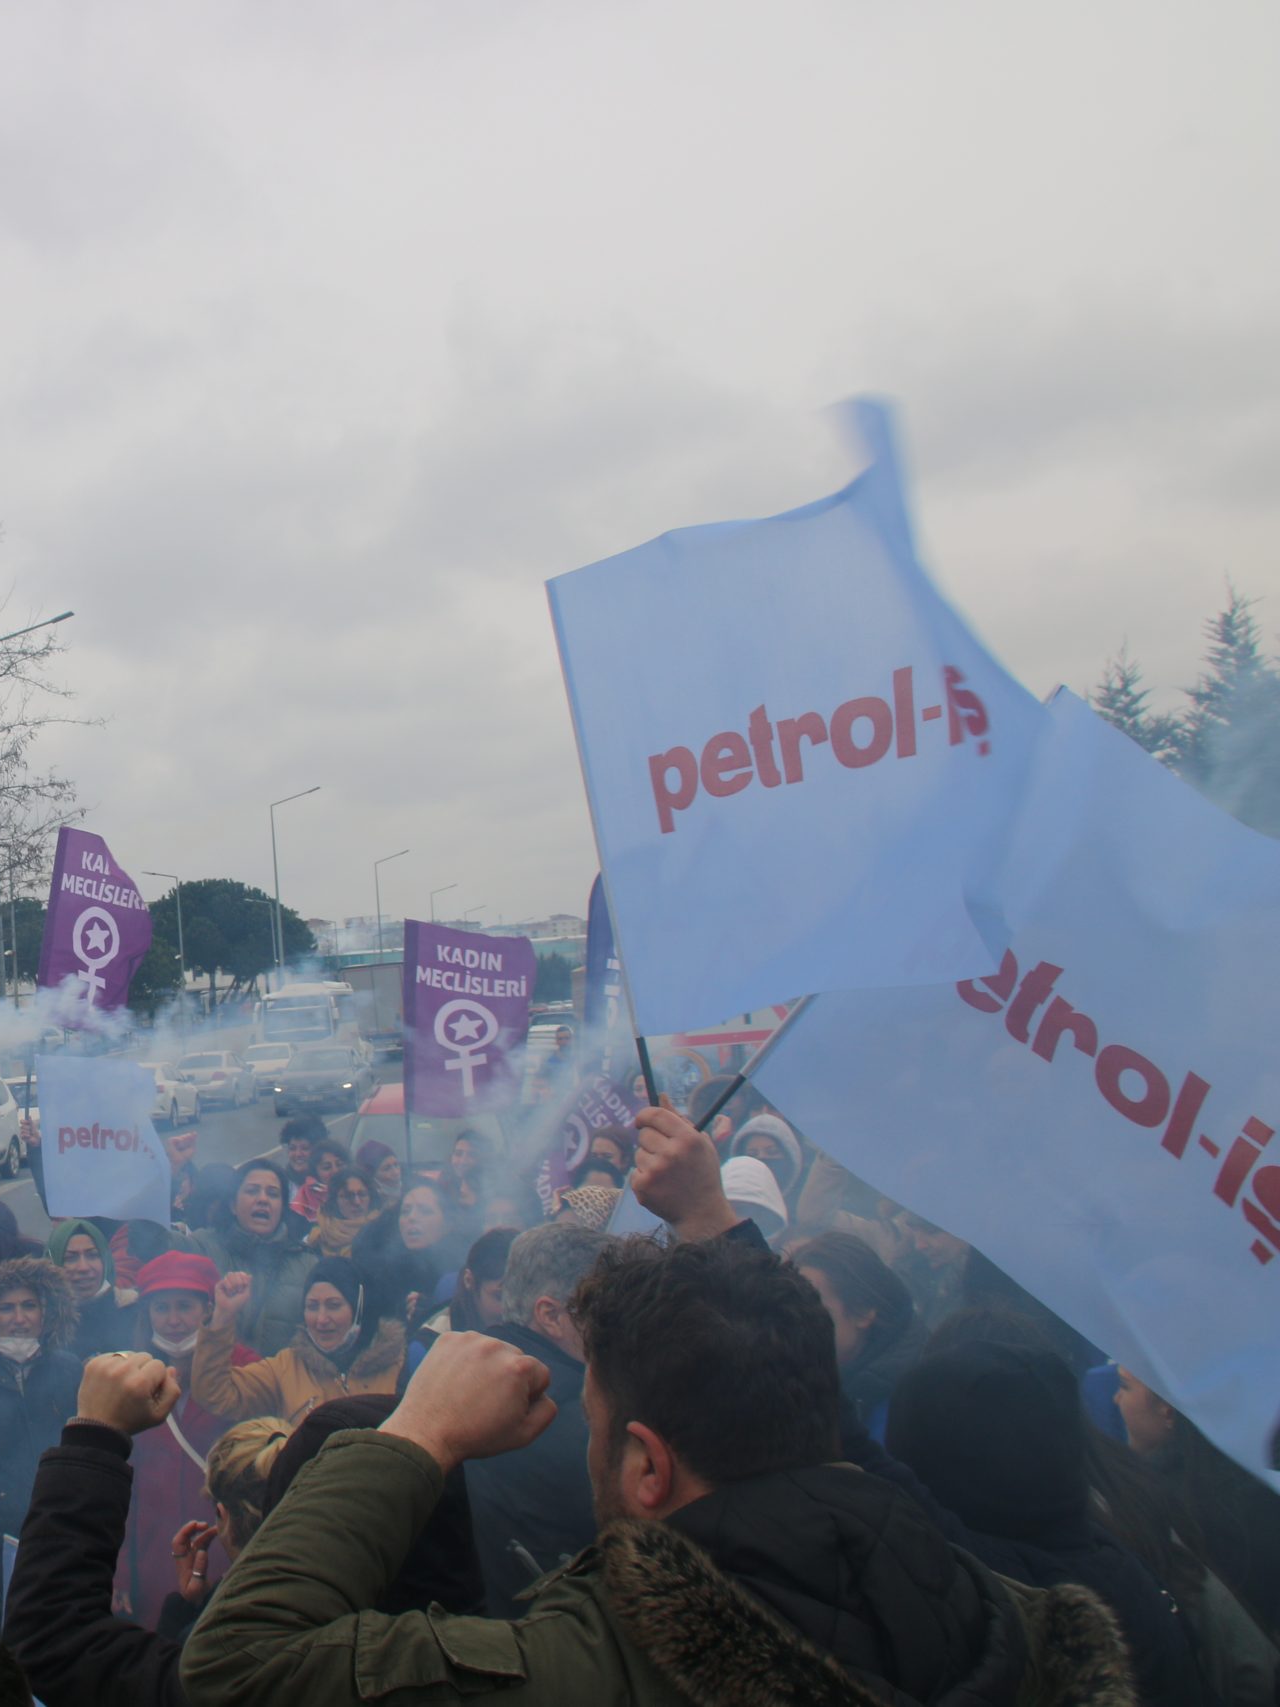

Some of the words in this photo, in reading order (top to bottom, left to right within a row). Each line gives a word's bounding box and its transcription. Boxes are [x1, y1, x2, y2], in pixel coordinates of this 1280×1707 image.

[437, 944, 502, 972] KADIN
[416, 965, 526, 997] MECLİSLERİ
[956, 948, 1280, 1265] etrol-iş
